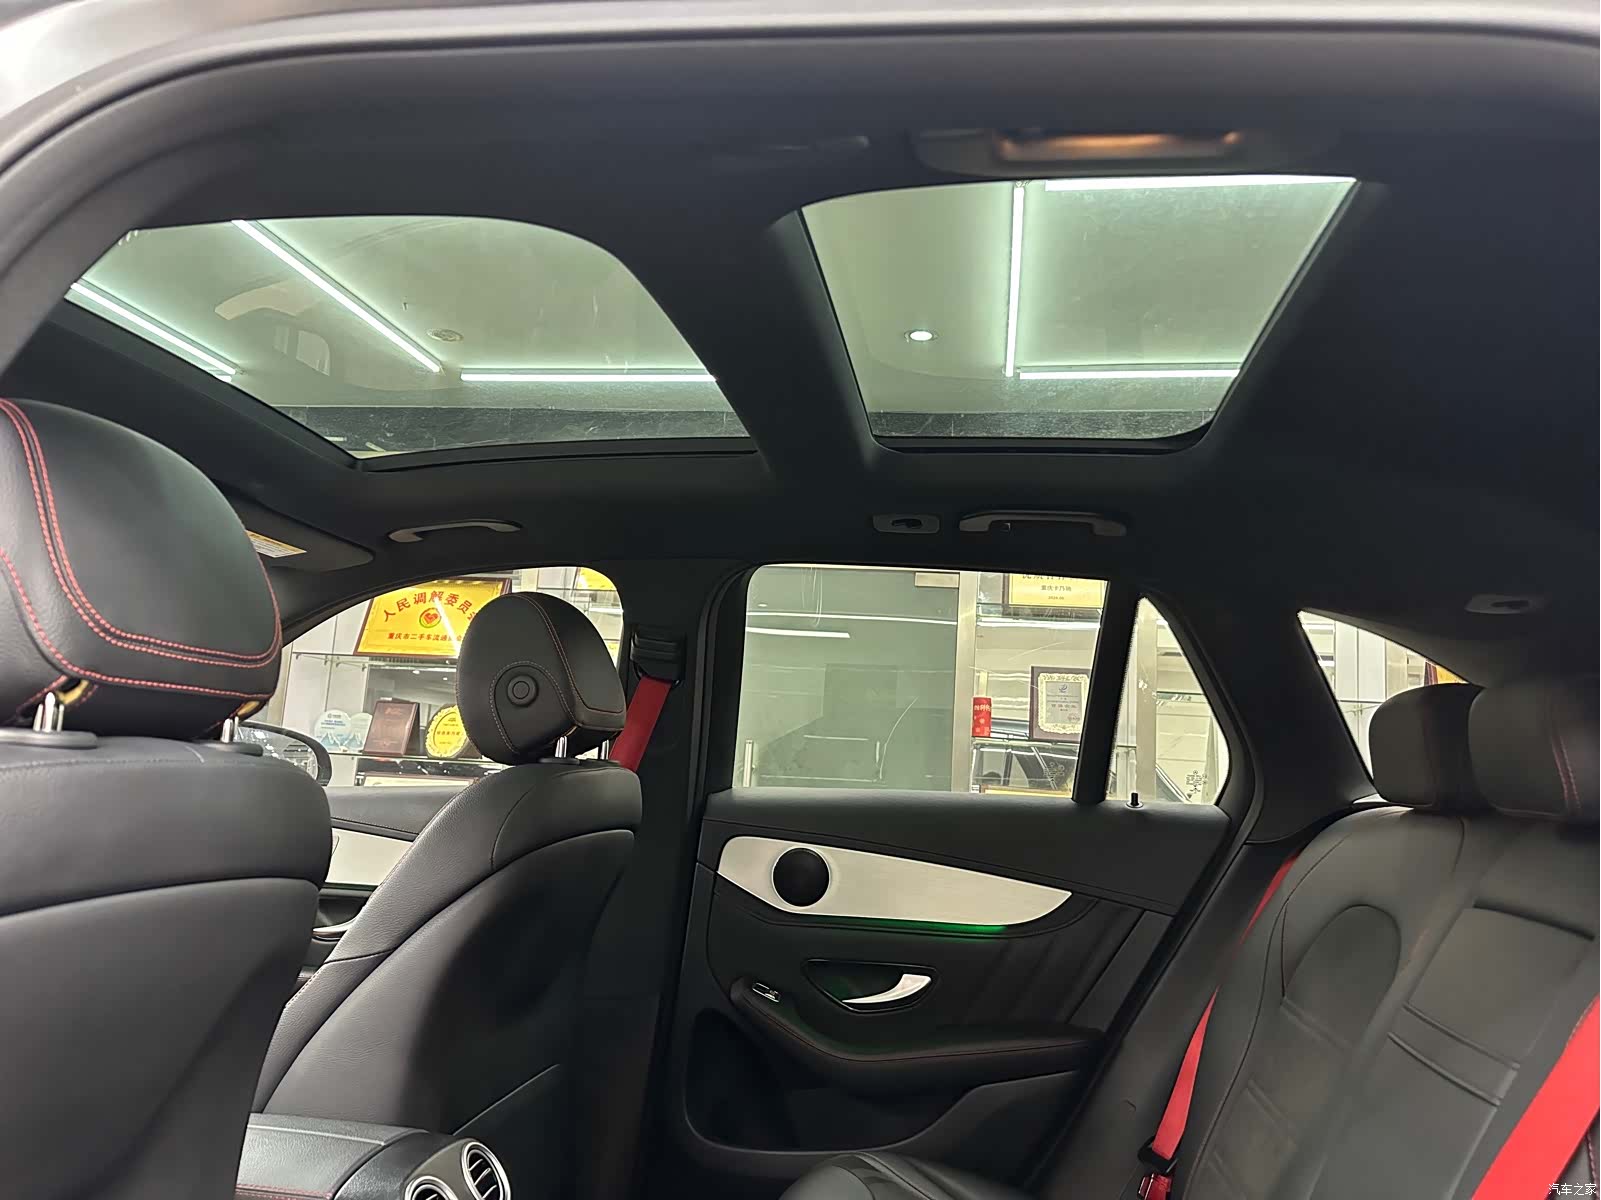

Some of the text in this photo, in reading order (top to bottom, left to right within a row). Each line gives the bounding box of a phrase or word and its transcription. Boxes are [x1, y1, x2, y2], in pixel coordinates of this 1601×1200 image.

[387, 632, 462, 641] 重庆市二手车流通会
